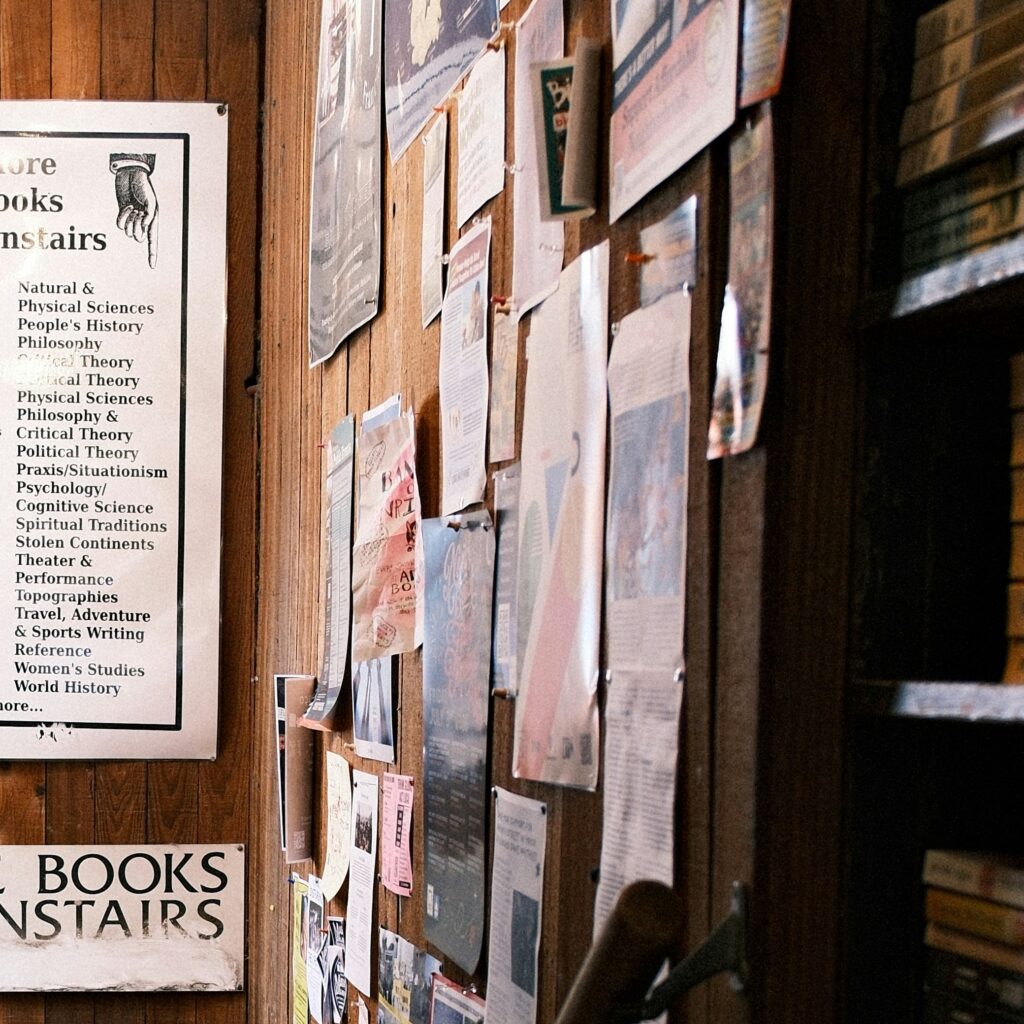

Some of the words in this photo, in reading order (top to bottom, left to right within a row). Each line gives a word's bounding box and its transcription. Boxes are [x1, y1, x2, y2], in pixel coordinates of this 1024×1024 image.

[18, 281, 77, 294] Natural
[82, 282, 95, 295] &
[18, 299, 81, 316] Physical
[87, 300, 154, 316] Sciences
[17, 318, 81, 334] People's
[86, 319, 144, 335] History
[17, 336, 103, 353] Philosophy
[80, 355, 134, 371] Theory
[86, 374, 140, 390] Theory
[17, 390, 81, 406] Physical
[86, 391, 153, 406] Sciences
[17, 408, 102, 427] Philosophy
[105, 410, 120, 425] &
[16, 426, 75, 442] Critical
[78, 427, 133, 445] Theory
[16, 445, 79, 458] Political
[84, 446, 139, 462] Theory
[17, 463, 168, 482] Praxis/Situationism
[16, 481, 107, 499] Psychology/
[16, 499, 88, 517] Cognitive
[94, 500, 153, 516] Science
[16, 517, 83, 536] Spiritual
[88, 518, 167, 534] Traditions
[16, 535, 65, 551] Stolen
[70, 536, 154, 551] Continents
[15, 554, 75, 567] Theater
[79, 555, 93, 568] &
[15, 571, 113, 587] Performance
[14, 589, 118, 608] Topographies
[14, 607, 67, 624] Travel,
[71, 608, 151, 622] Adventure
[15, 625, 27, 637] &
[32, 626, 81, 641] Sports
[87, 627, 145, 643] Writing
[14, 643, 92, 657] Reference
[14, 662, 82, 676] Women's
[88, 663, 145, 677] Studies
[14, 680, 59, 694] World
[64, 681, 121, 697] History
[37, 852, 228, 895] BOOKS
